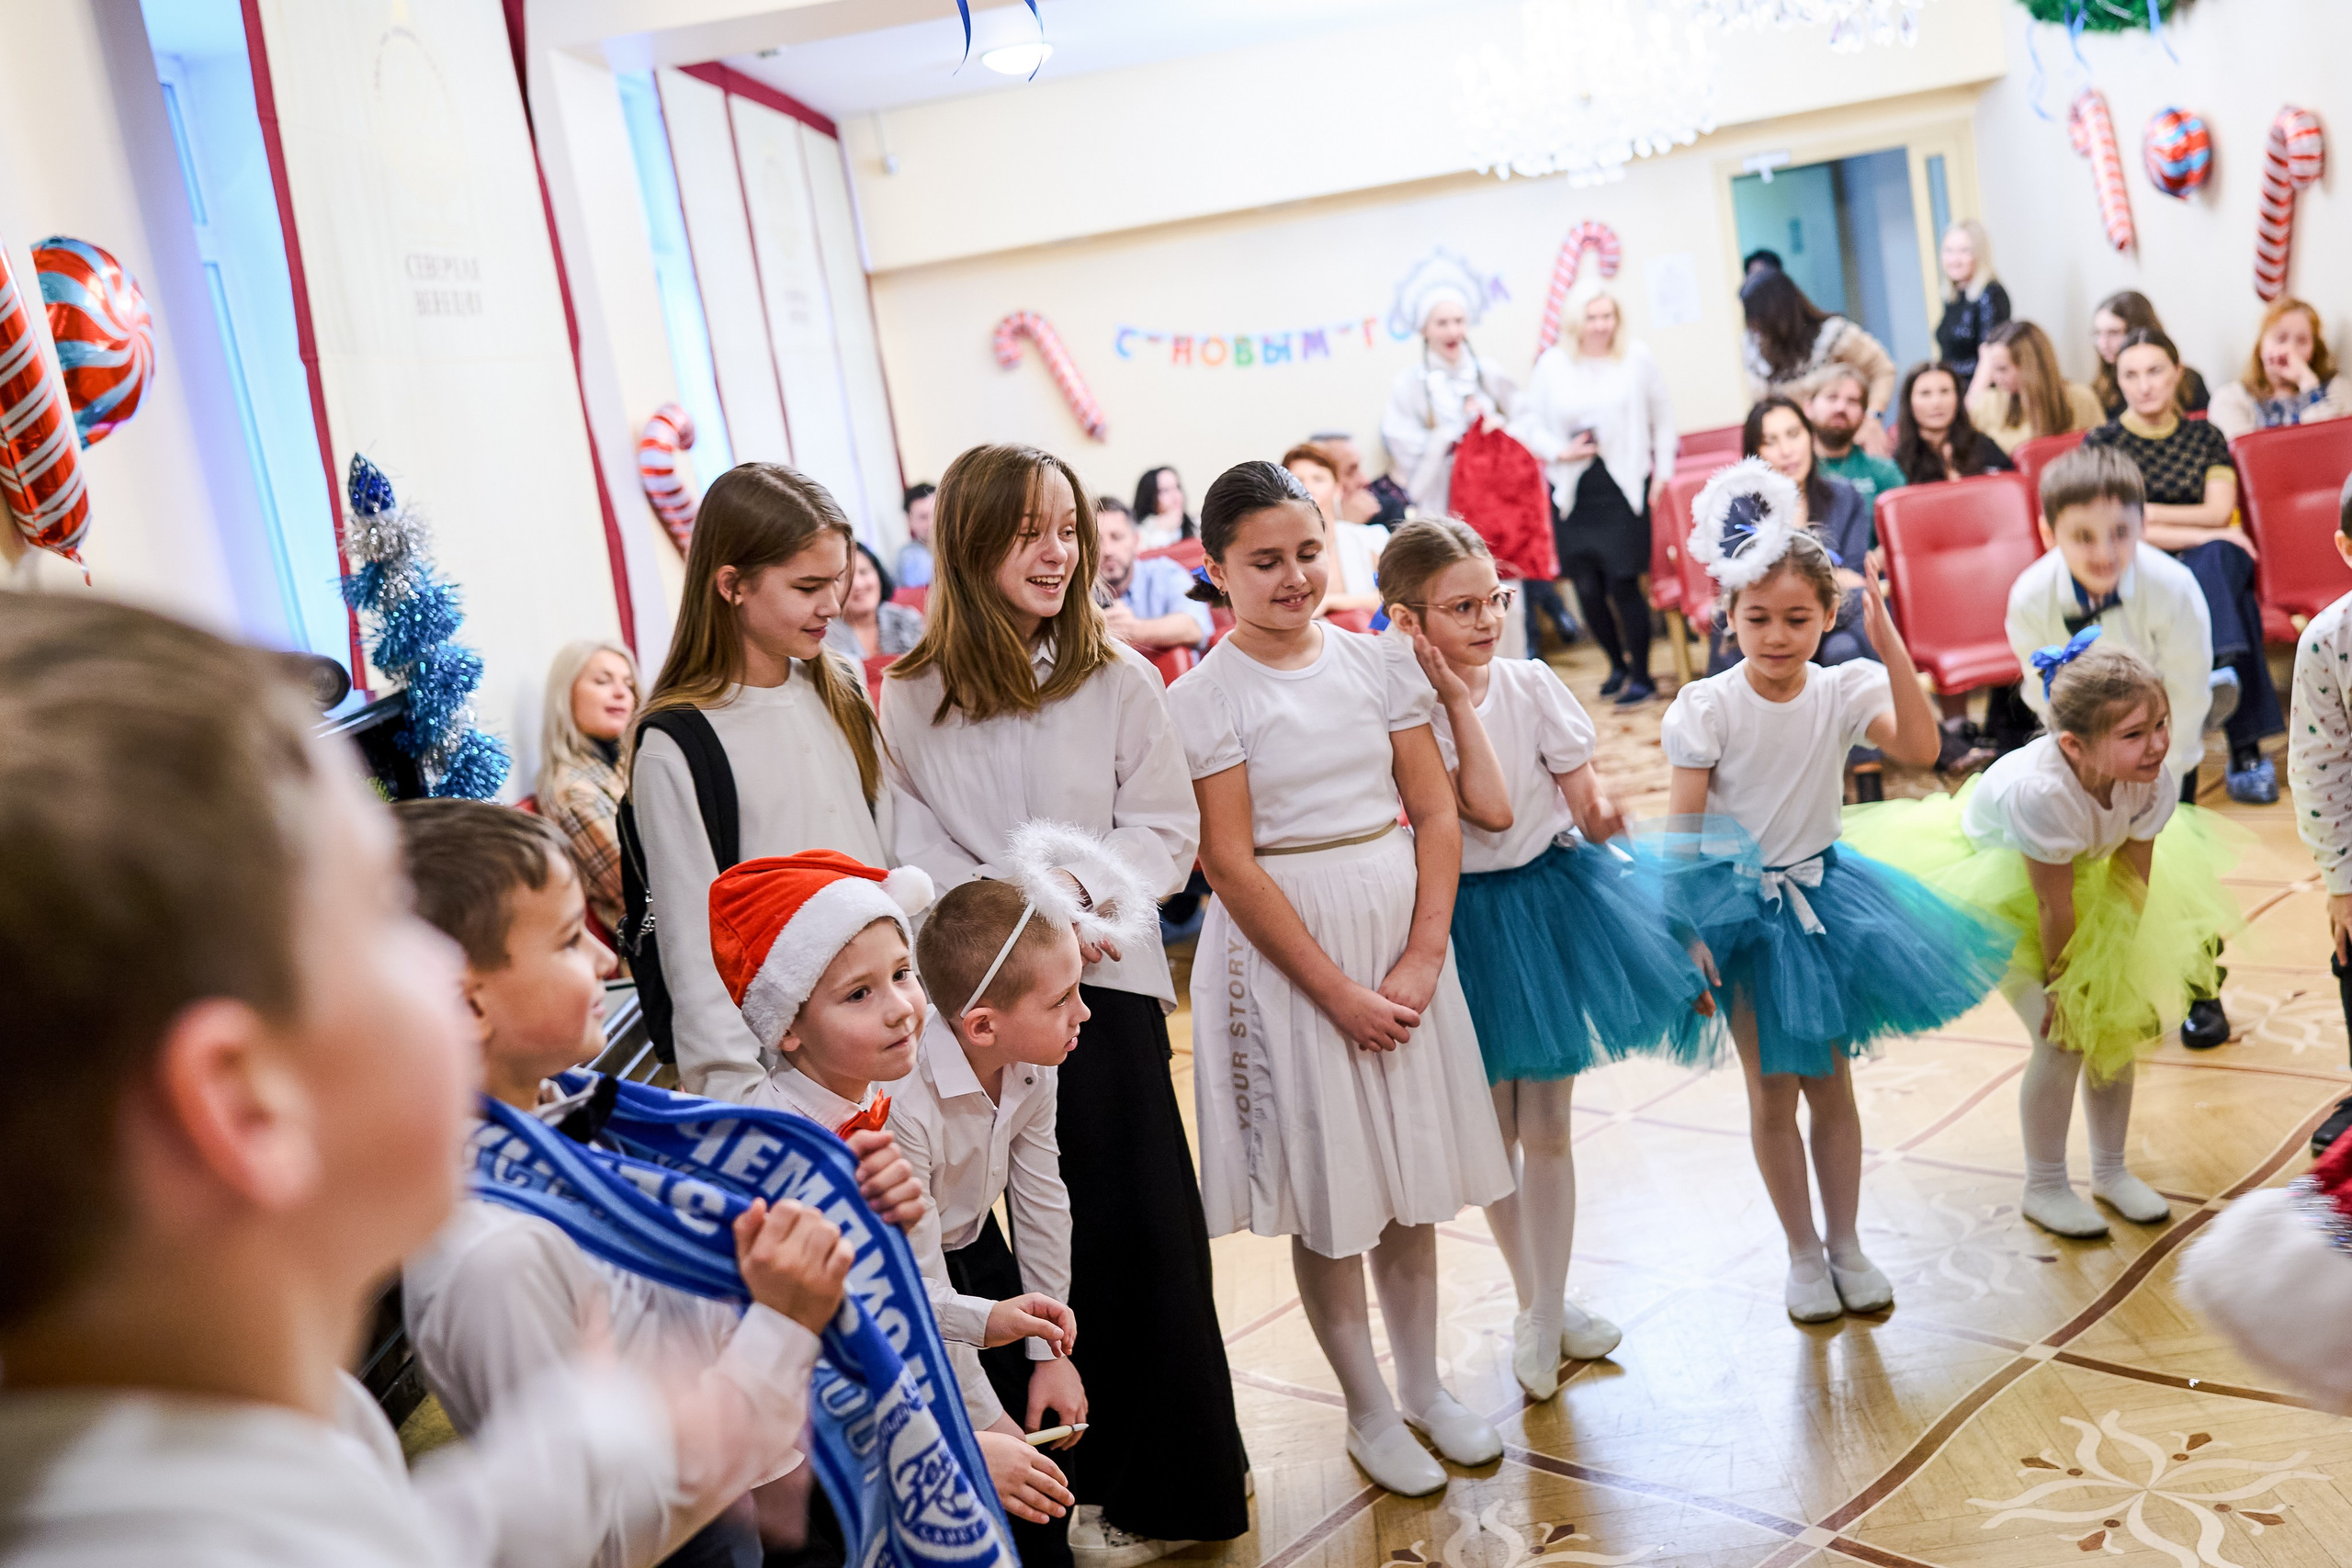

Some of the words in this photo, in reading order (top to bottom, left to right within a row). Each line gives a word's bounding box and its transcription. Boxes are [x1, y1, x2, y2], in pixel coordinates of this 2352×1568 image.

[1114, 327, 1139, 359] С
[1171, 328, 1331, 367] НОВЫМ
[1227, 938, 1248, 1039] STORY
[1232, 1051, 1251, 1131] YOUR
